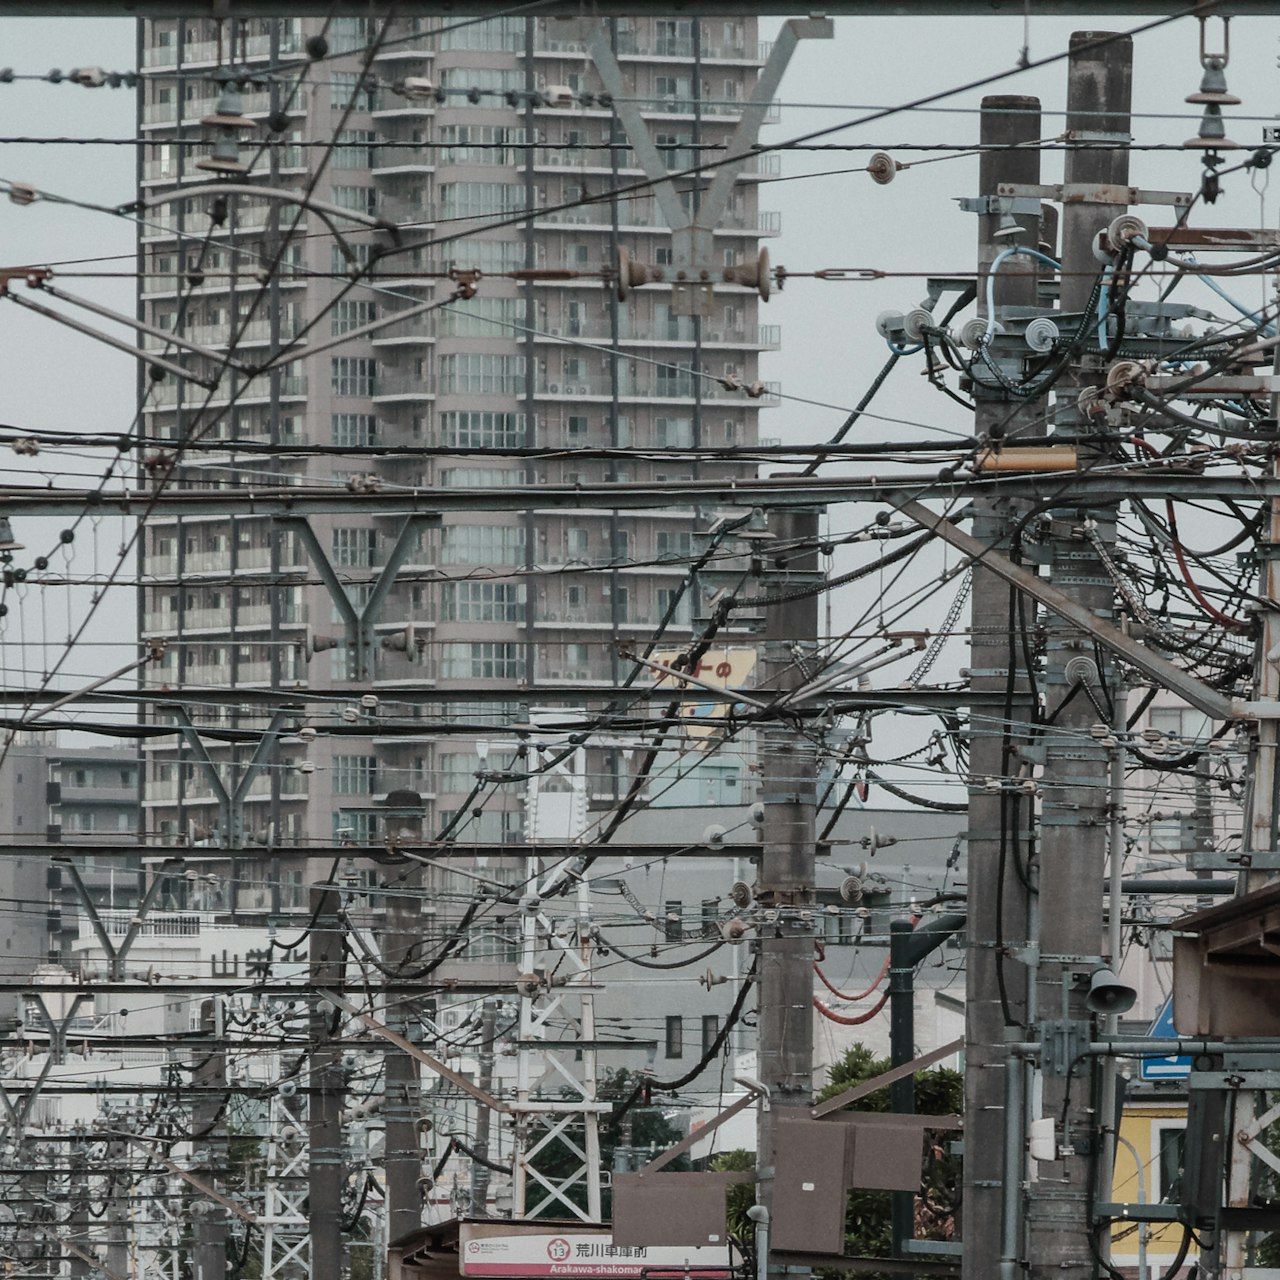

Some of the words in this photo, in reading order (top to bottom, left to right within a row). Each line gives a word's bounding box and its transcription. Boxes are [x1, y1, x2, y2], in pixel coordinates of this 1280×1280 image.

[553, 1248, 566, 1258] 13
[576, 1243, 648, 1258] 荒川車庫前
